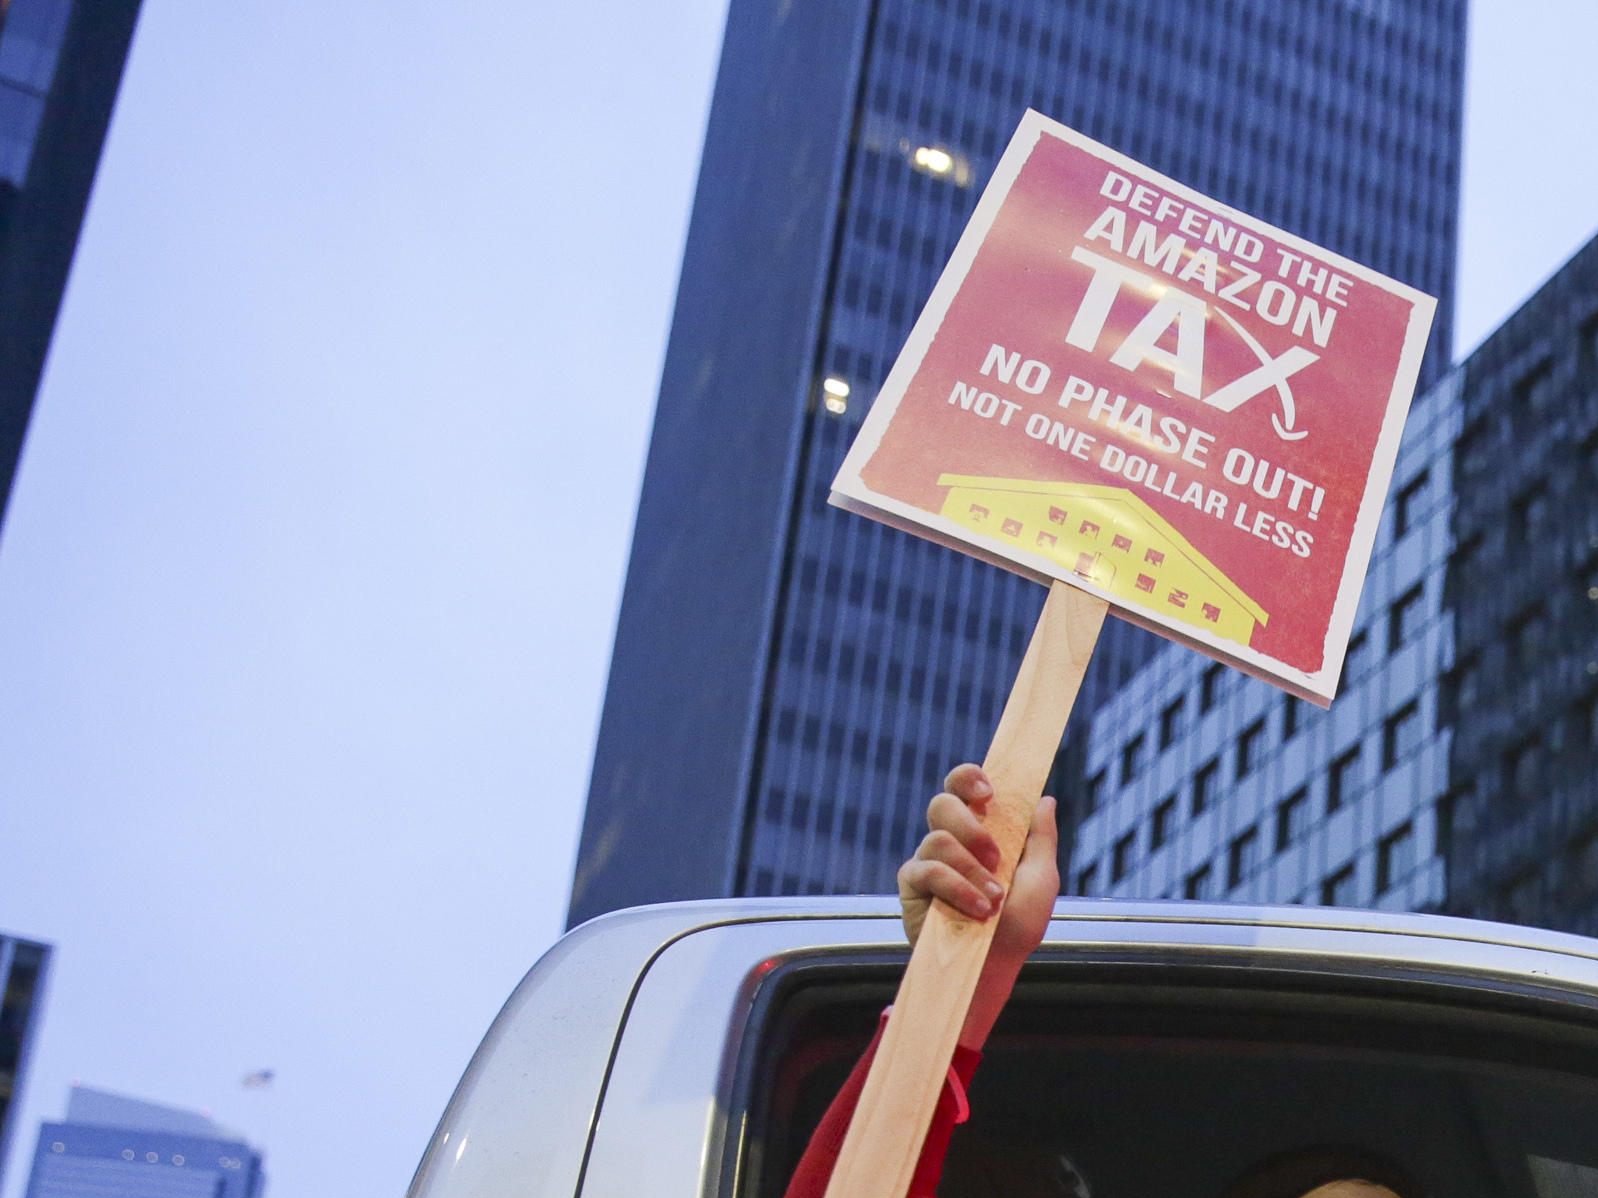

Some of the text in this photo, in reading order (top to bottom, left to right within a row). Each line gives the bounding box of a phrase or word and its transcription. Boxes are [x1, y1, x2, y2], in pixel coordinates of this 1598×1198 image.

[1083, 205, 1338, 349] AMAZON
[1099, 170, 1354, 308] DEFEND THE
[1064, 245, 1321, 440] TAX
[947, 380, 1315, 558] NOT ONE DOLLAR LESS
[979, 343, 1326, 521] NO PHASE OUT!
